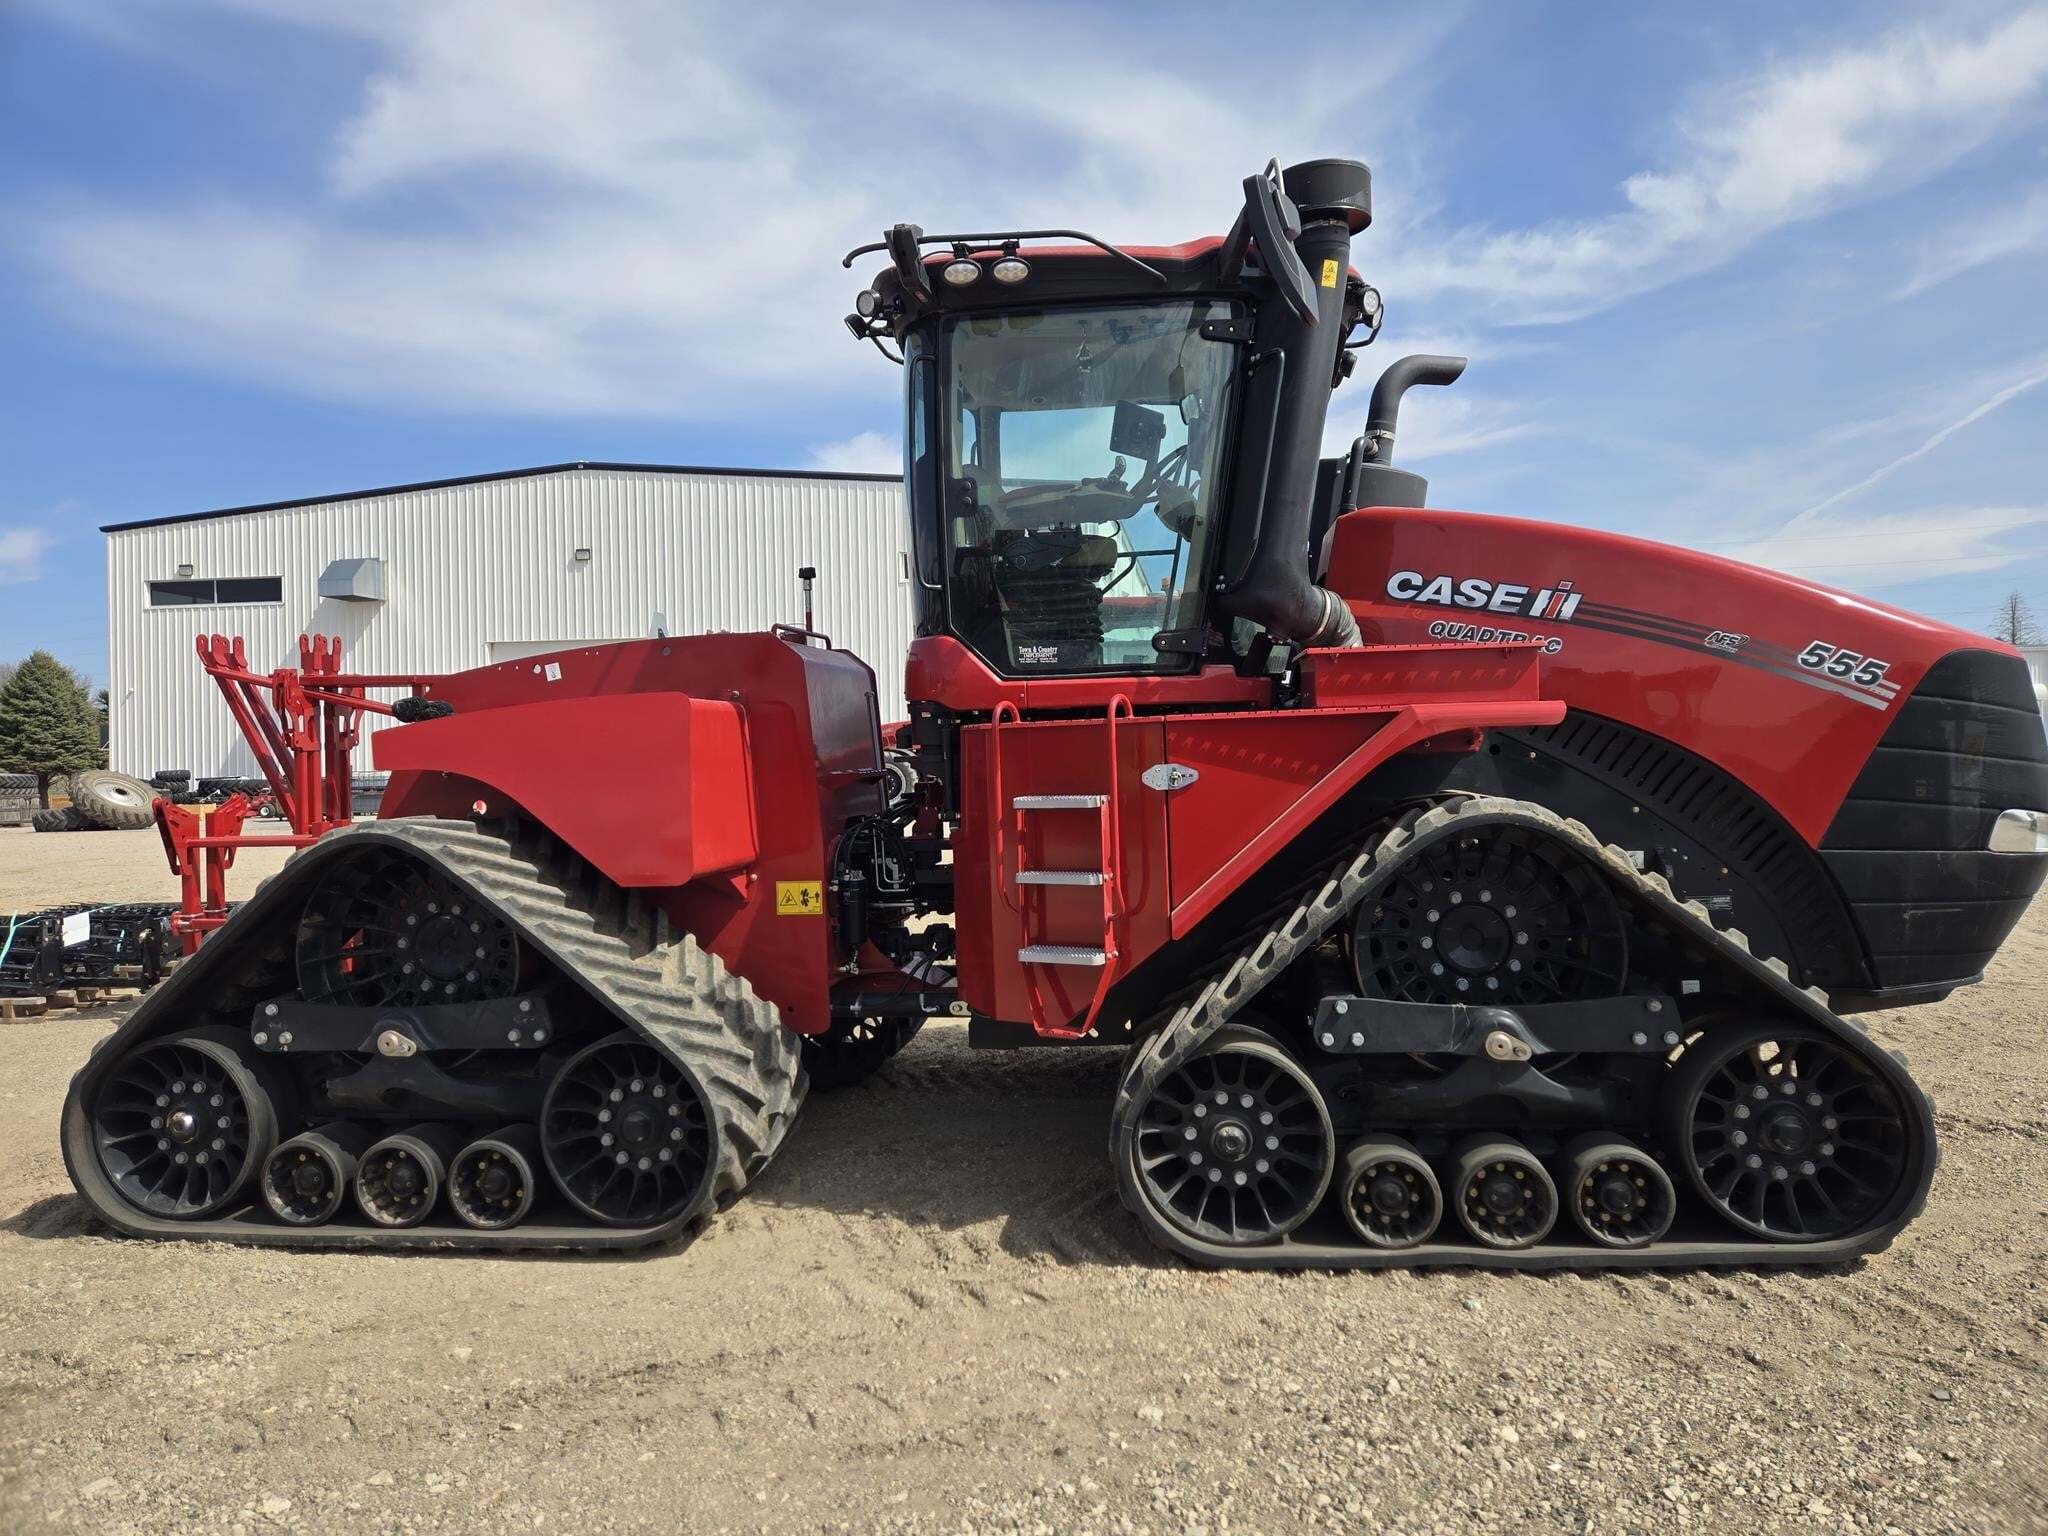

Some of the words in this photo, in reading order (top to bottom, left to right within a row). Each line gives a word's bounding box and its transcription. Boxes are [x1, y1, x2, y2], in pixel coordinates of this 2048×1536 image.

[1386, 570, 1530, 614] CASE
[1428, 620, 1563, 655] QUADTRC
[1797, 639, 1891, 688] 555
